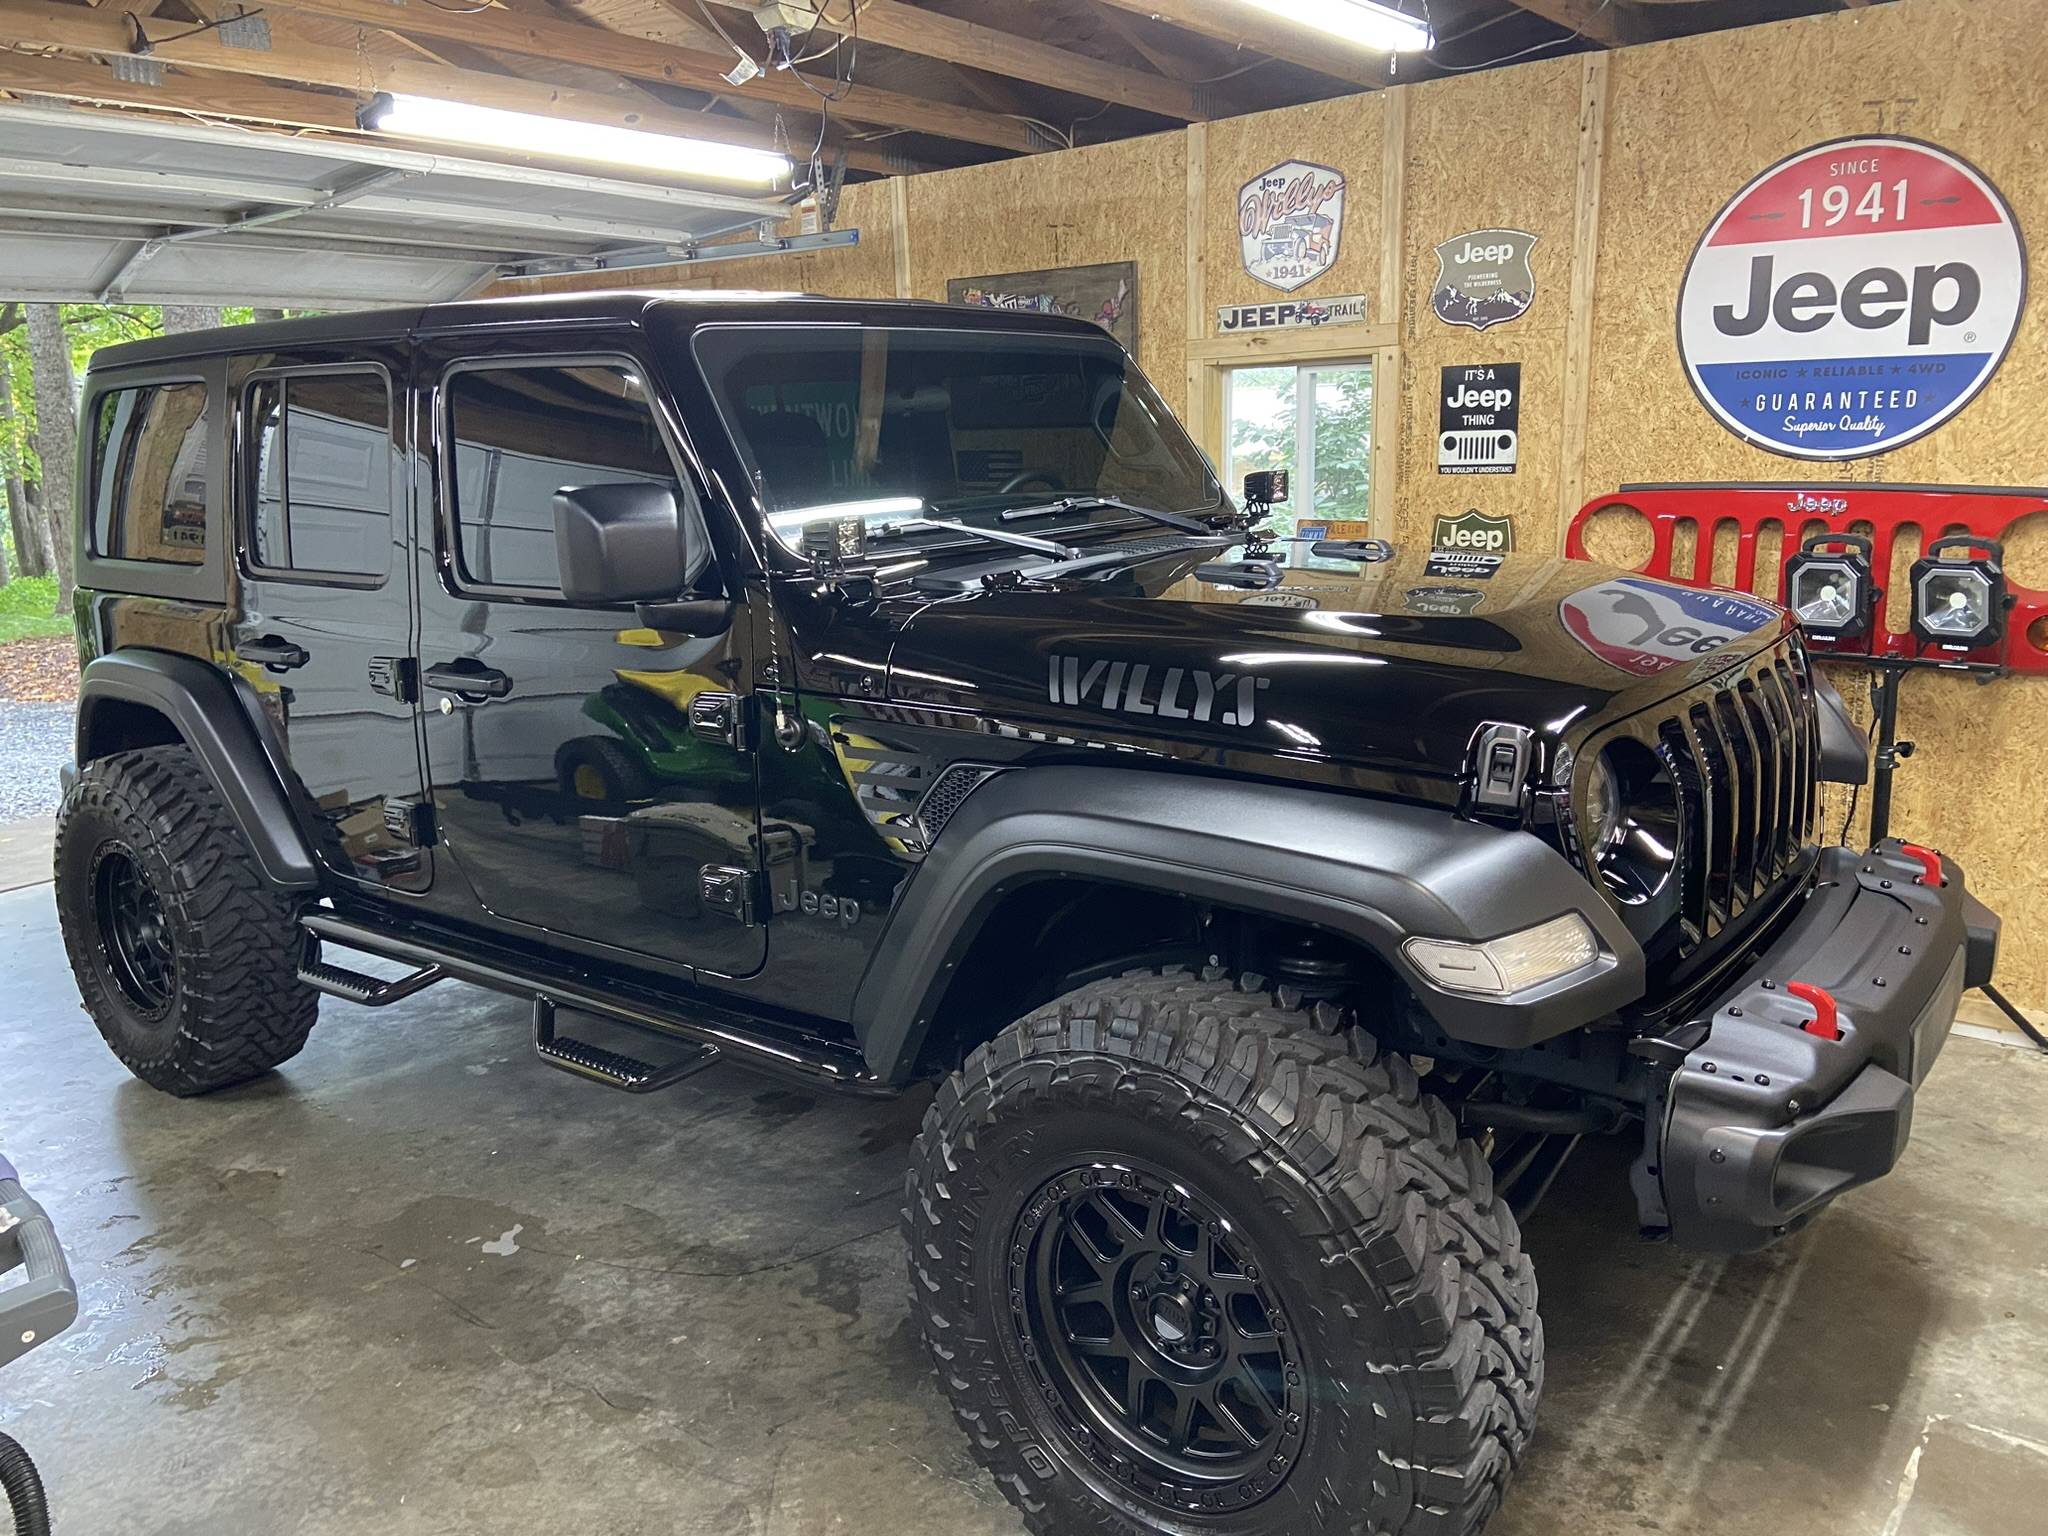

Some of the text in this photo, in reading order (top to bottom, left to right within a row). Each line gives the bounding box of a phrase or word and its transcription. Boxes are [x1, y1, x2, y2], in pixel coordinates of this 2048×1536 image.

[1830, 159, 1879, 176] SINCE
[1259, 178, 1285, 191] Jeep
[1239, 171, 1346, 239] Willys
[1798, 179, 1908, 228] 1941
[1454, 242, 1514, 265] Jeep
[1273, 264, 1305, 279] 1941
[1713, 255, 1981, 346] Jeep
[1223, 301, 1360, 329] JEEP TRAIL
[1465, 369, 1495, 381] IT'S A
[1736, 363, 1946, 380] ICONIC RELIABLE 4WD
[1447, 384, 1512, 411] Jeep
[1756, 389, 1917, 411] GUARANTEED
[1462, 414, 1495, 426] THING
[1782, 415, 1886, 438] Superior Quality
[1787, 493, 1848, 516] Jeep
[1442, 524, 1503, 551] Jeep
[1049, 655, 1270, 727] WILLYS
[779, 880, 860, 929] Jeep
